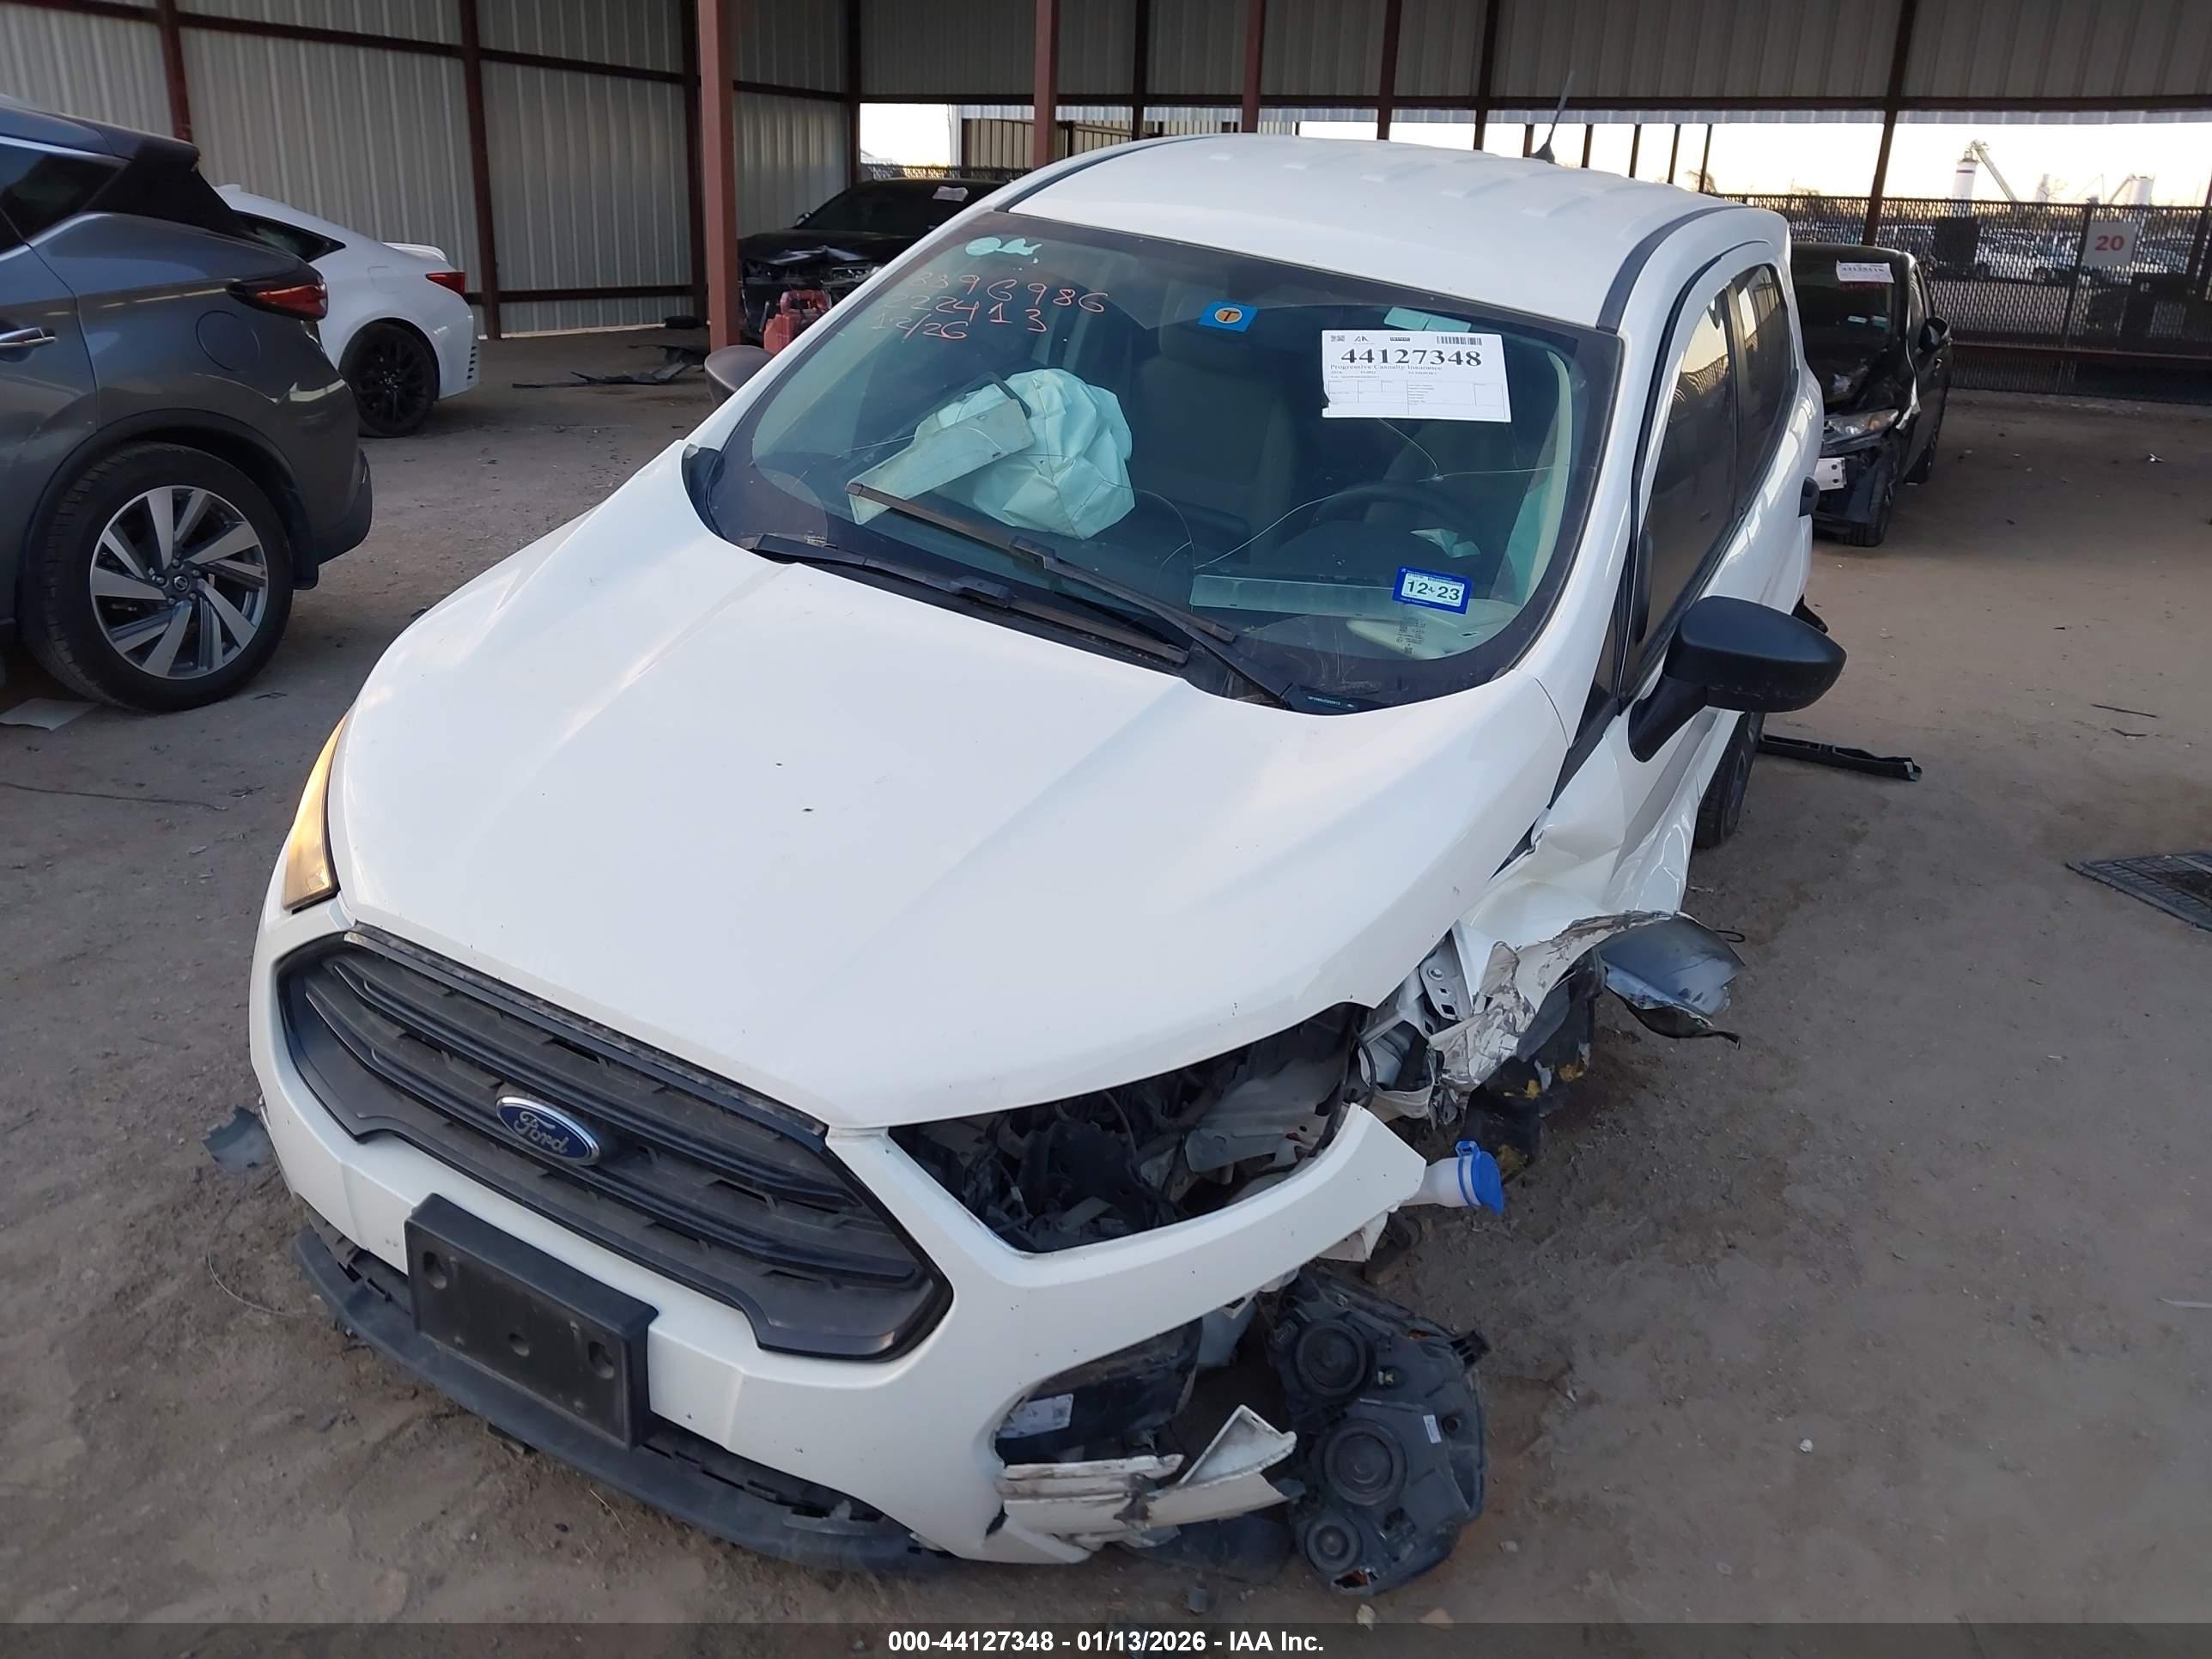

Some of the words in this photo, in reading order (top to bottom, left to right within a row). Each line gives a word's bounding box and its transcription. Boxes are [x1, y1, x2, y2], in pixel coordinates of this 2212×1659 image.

[2094, 235, 2124, 251] 20
[1224, 309, 1239, 321] T
[1340, 349, 1482, 367] 44127348
[1407, 580, 1429, 595] 12
[1437, 586, 1460, 601] 23
[514, 1112, 568, 1153] Ford
